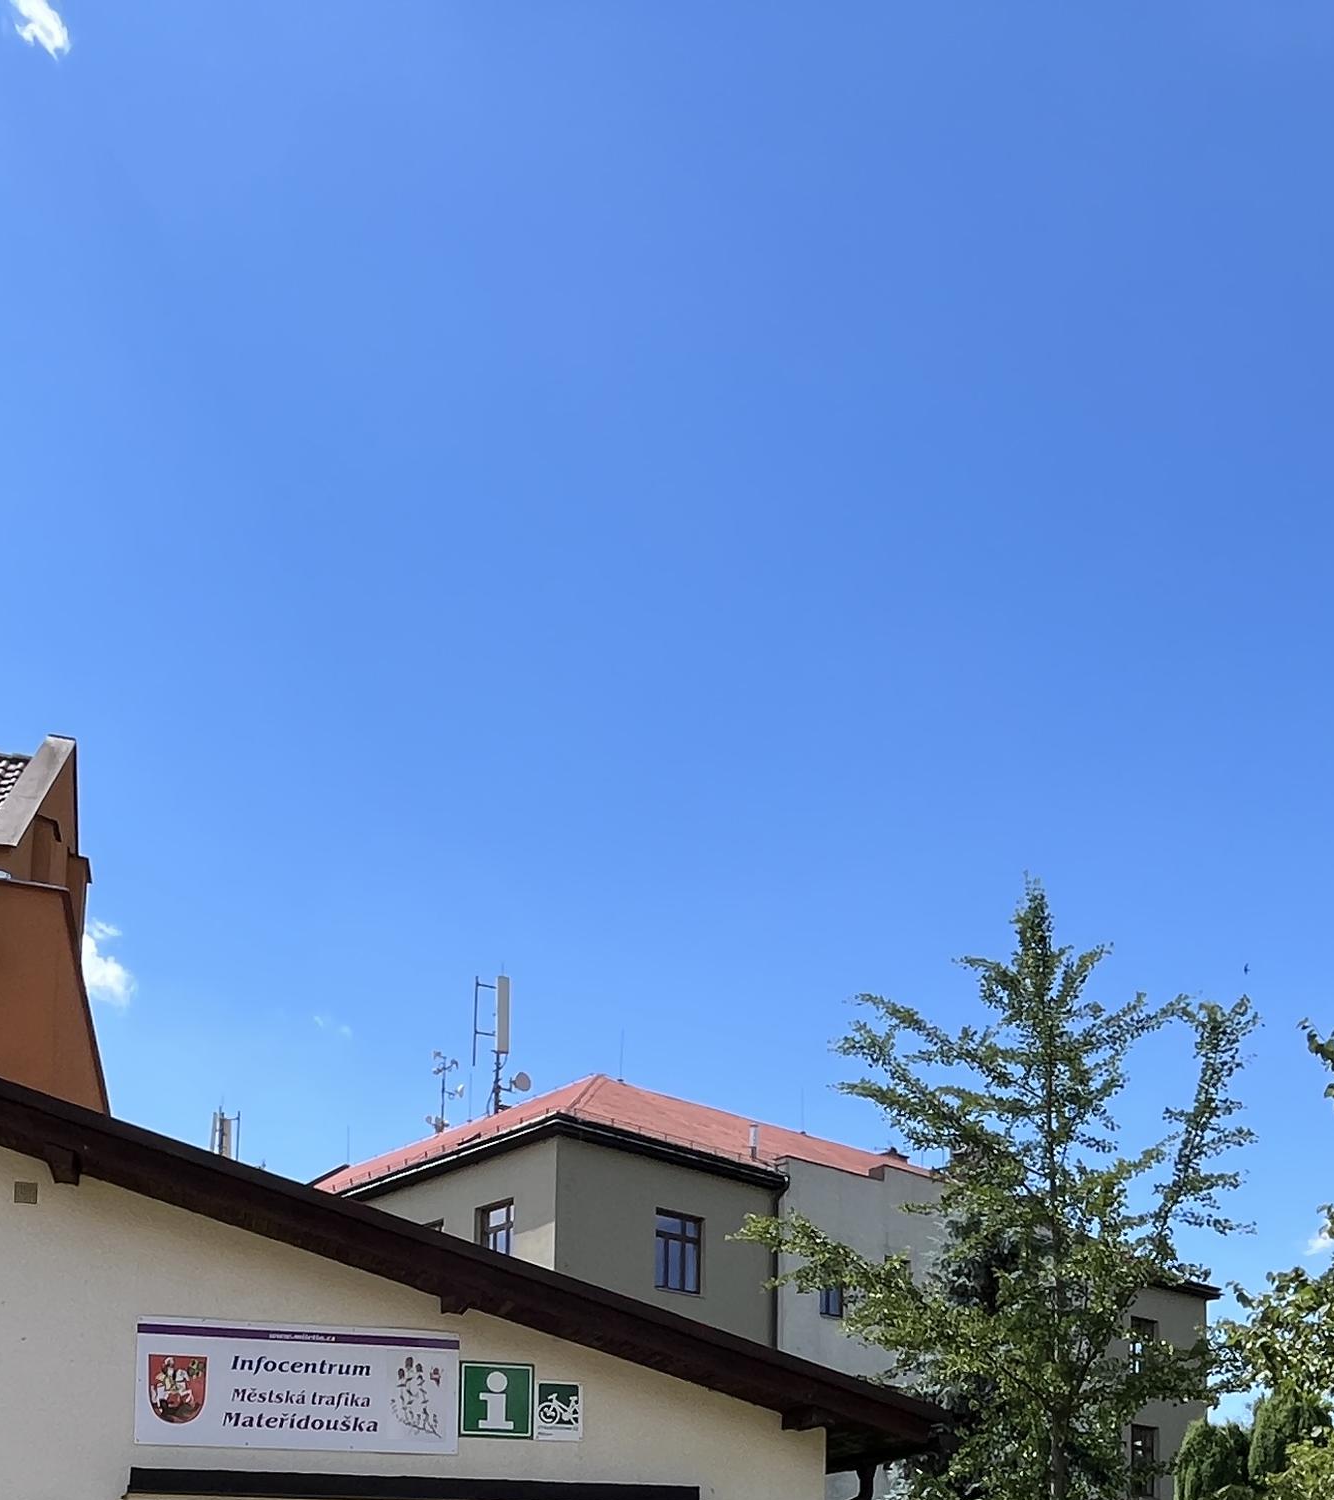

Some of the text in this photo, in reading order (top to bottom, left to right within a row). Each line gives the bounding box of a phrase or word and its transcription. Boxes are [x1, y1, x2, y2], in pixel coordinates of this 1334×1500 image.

[231, 1355, 371, 1376] Infocentrum
[231, 1388, 371, 1411] Městská trafika
[222, 1411, 379, 1433] Mateřídouška
